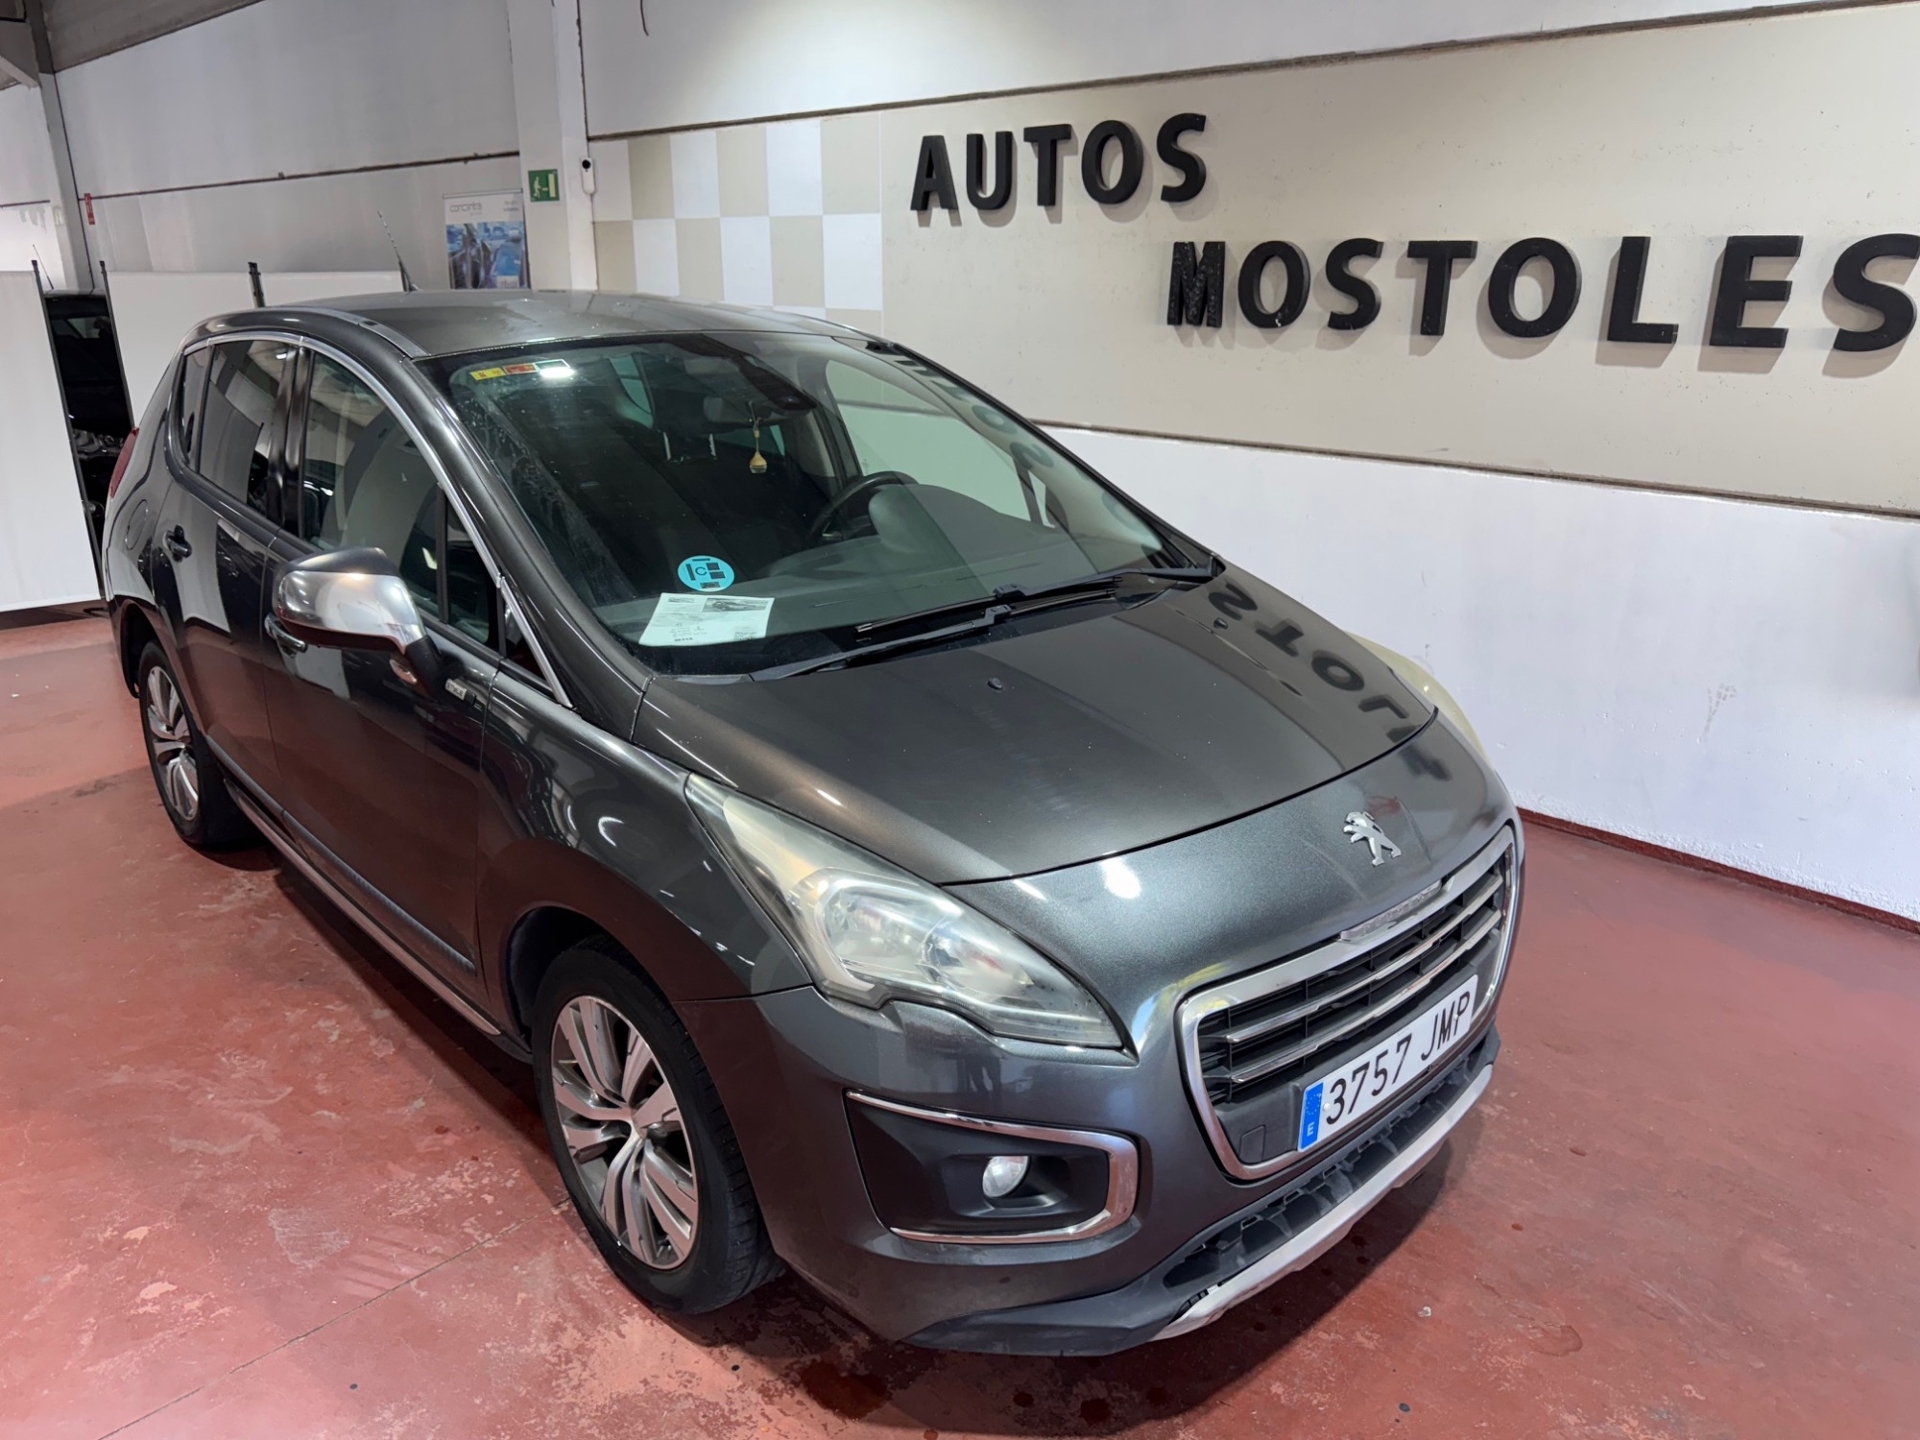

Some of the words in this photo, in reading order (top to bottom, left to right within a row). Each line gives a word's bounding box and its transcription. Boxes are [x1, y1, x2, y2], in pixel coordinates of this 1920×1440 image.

[910, 113, 1207, 211] AUTOS
[1167, 233, 1920, 352] MOSTOLES
[695, 566, 707, 575] C
[1326, 1033, 1412, 1125] 3757
[1421, 991, 1470, 1061] JMP
[1307, 1122, 1316, 1137] E
